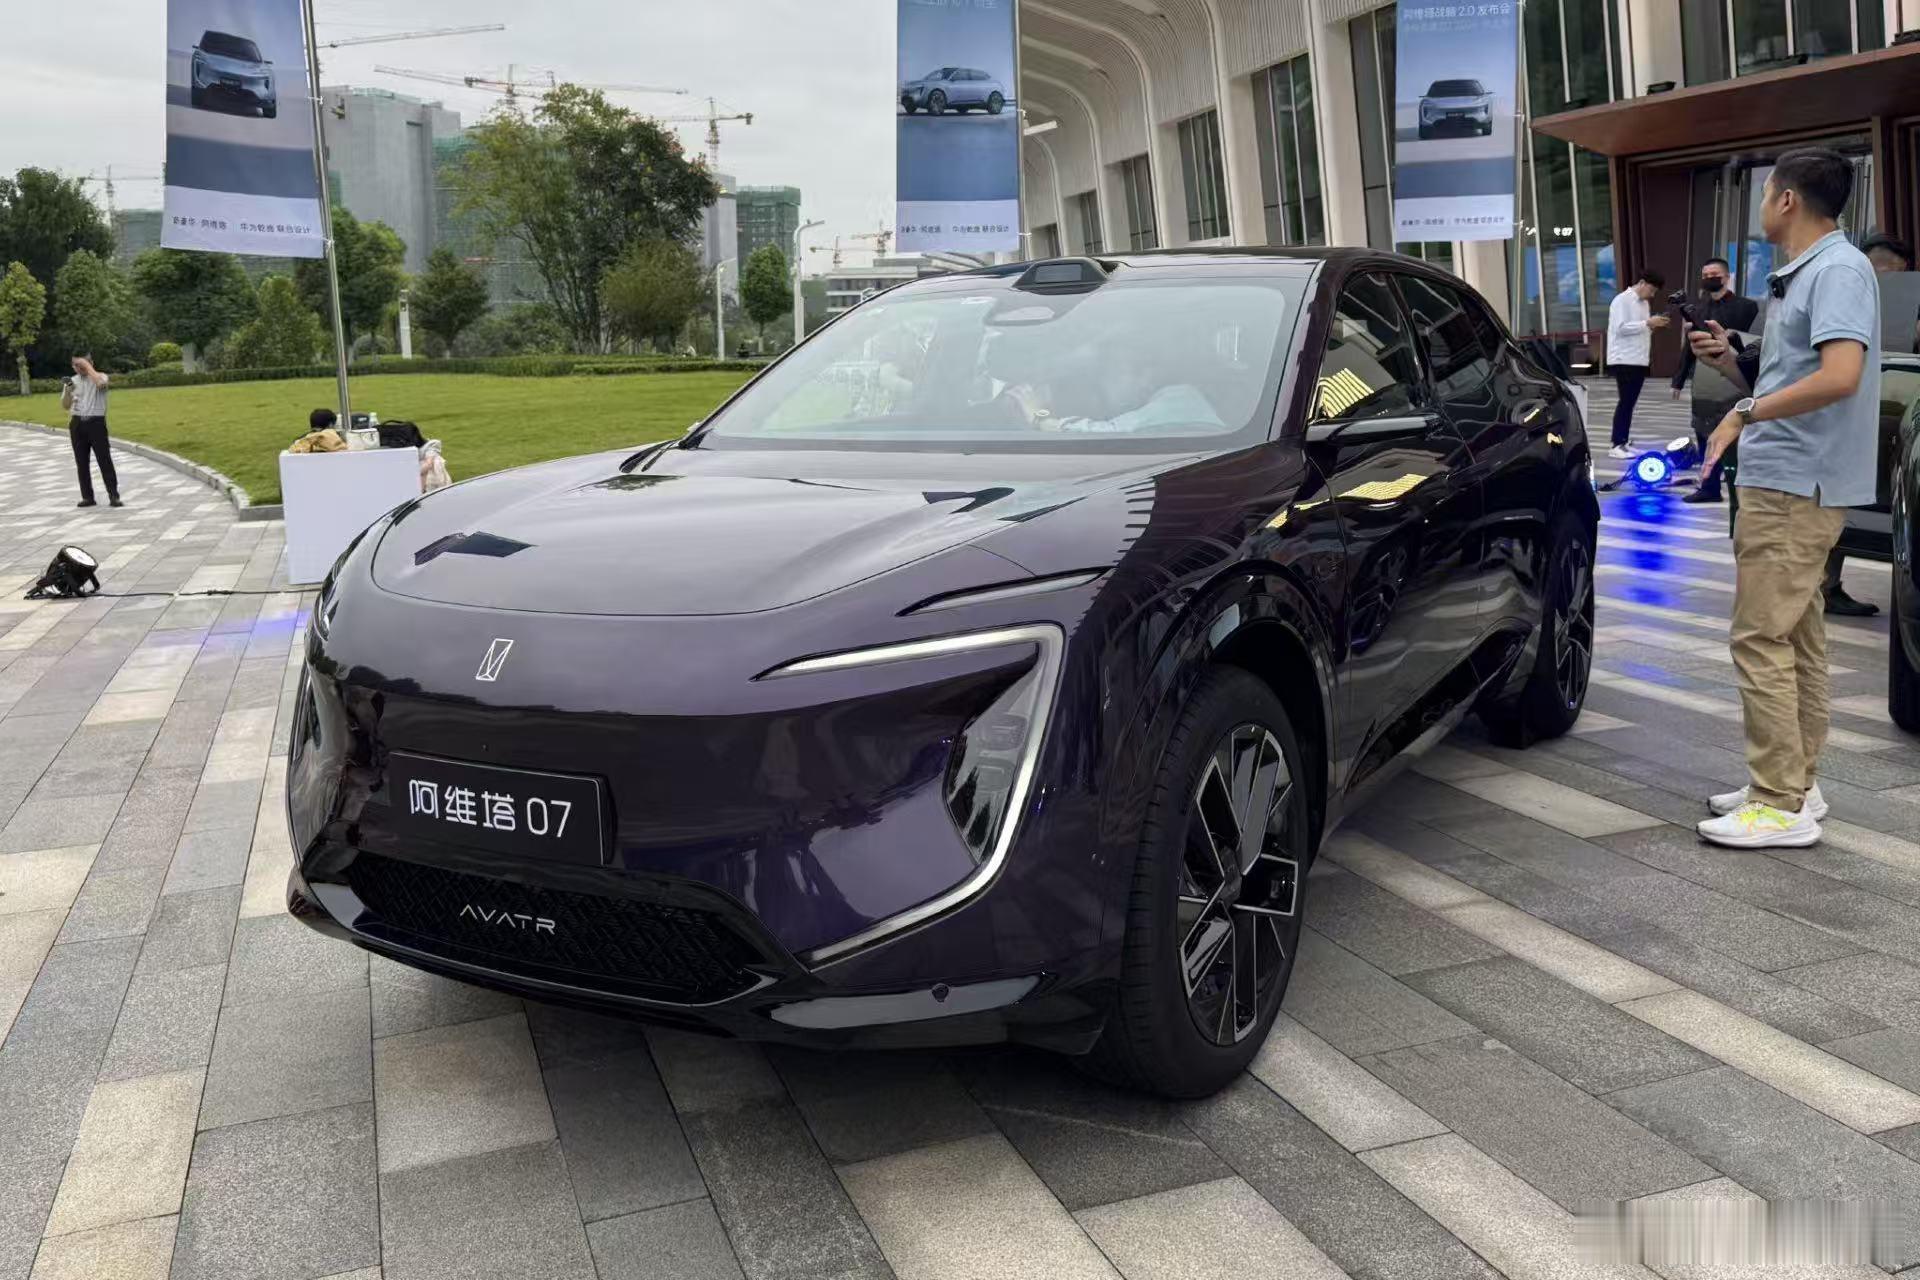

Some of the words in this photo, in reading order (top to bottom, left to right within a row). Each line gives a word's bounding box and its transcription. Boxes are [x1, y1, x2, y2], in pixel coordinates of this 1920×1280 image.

[409, 779, 516, 832] 阿维塔
[526, 797, 571, 838] 07
[459, 904, 556, 935] AVATR
